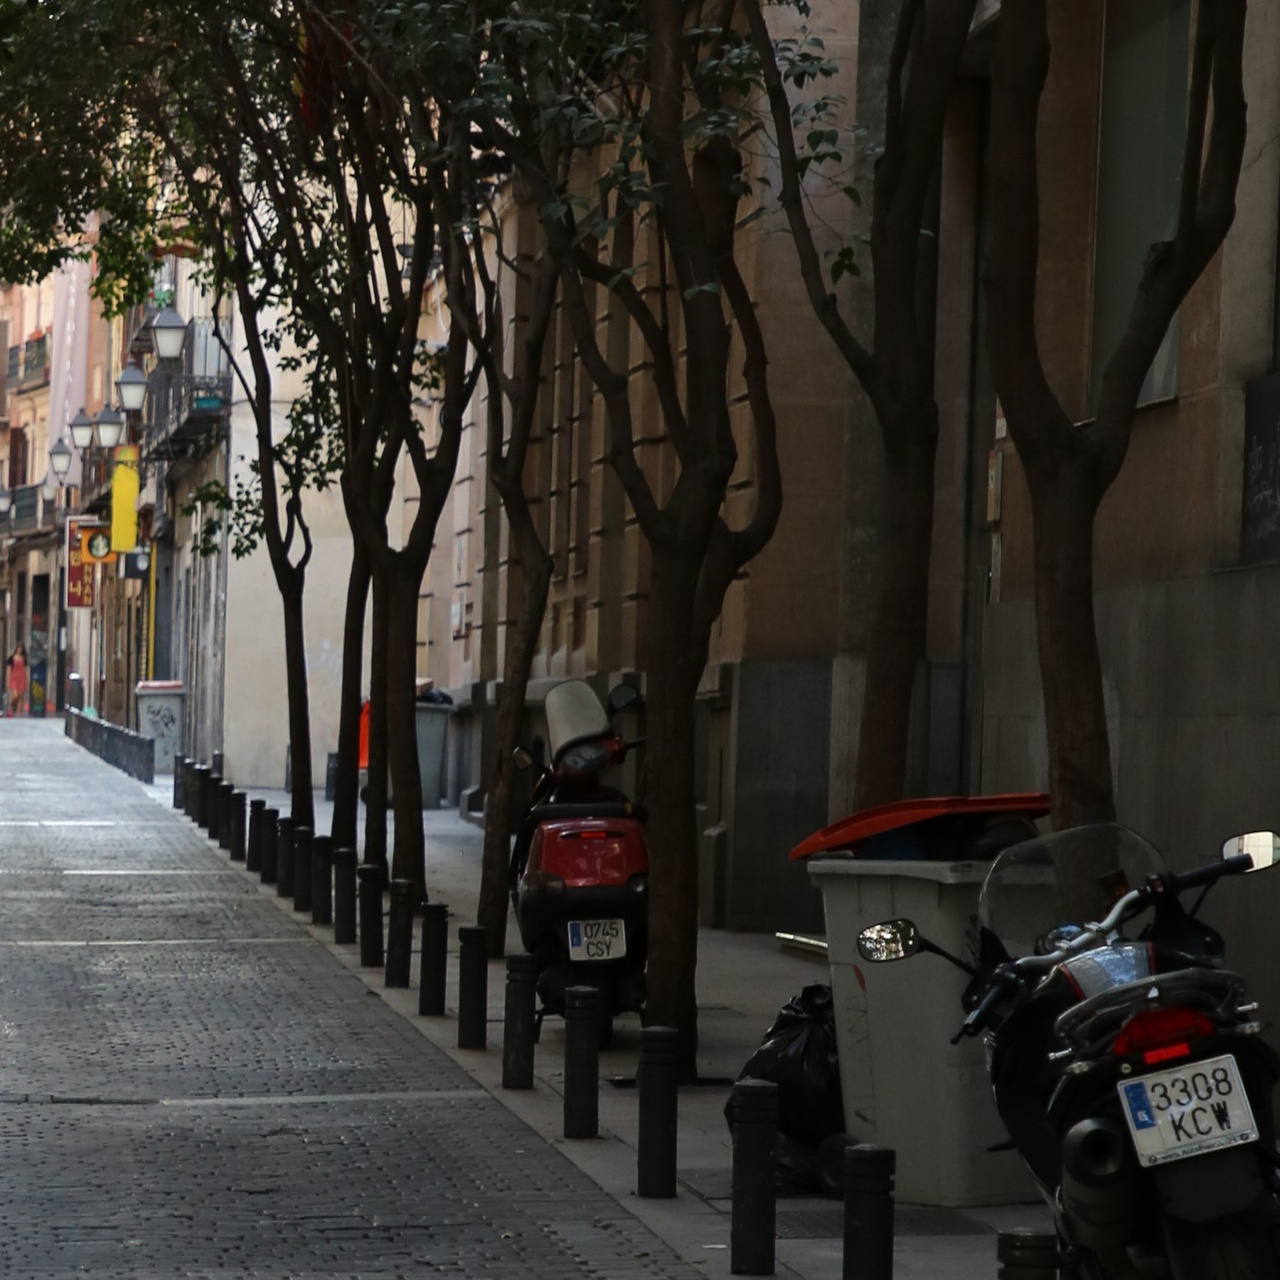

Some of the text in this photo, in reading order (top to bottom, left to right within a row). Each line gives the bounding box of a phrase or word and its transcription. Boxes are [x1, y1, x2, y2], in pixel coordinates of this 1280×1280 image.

[584, 922, 619, 939] 0745
[586, 940, 611, 958] CSY
[1150, 1067, 1233, 1111] 3308
[1170, 1100, 1232, 1142] KCW
